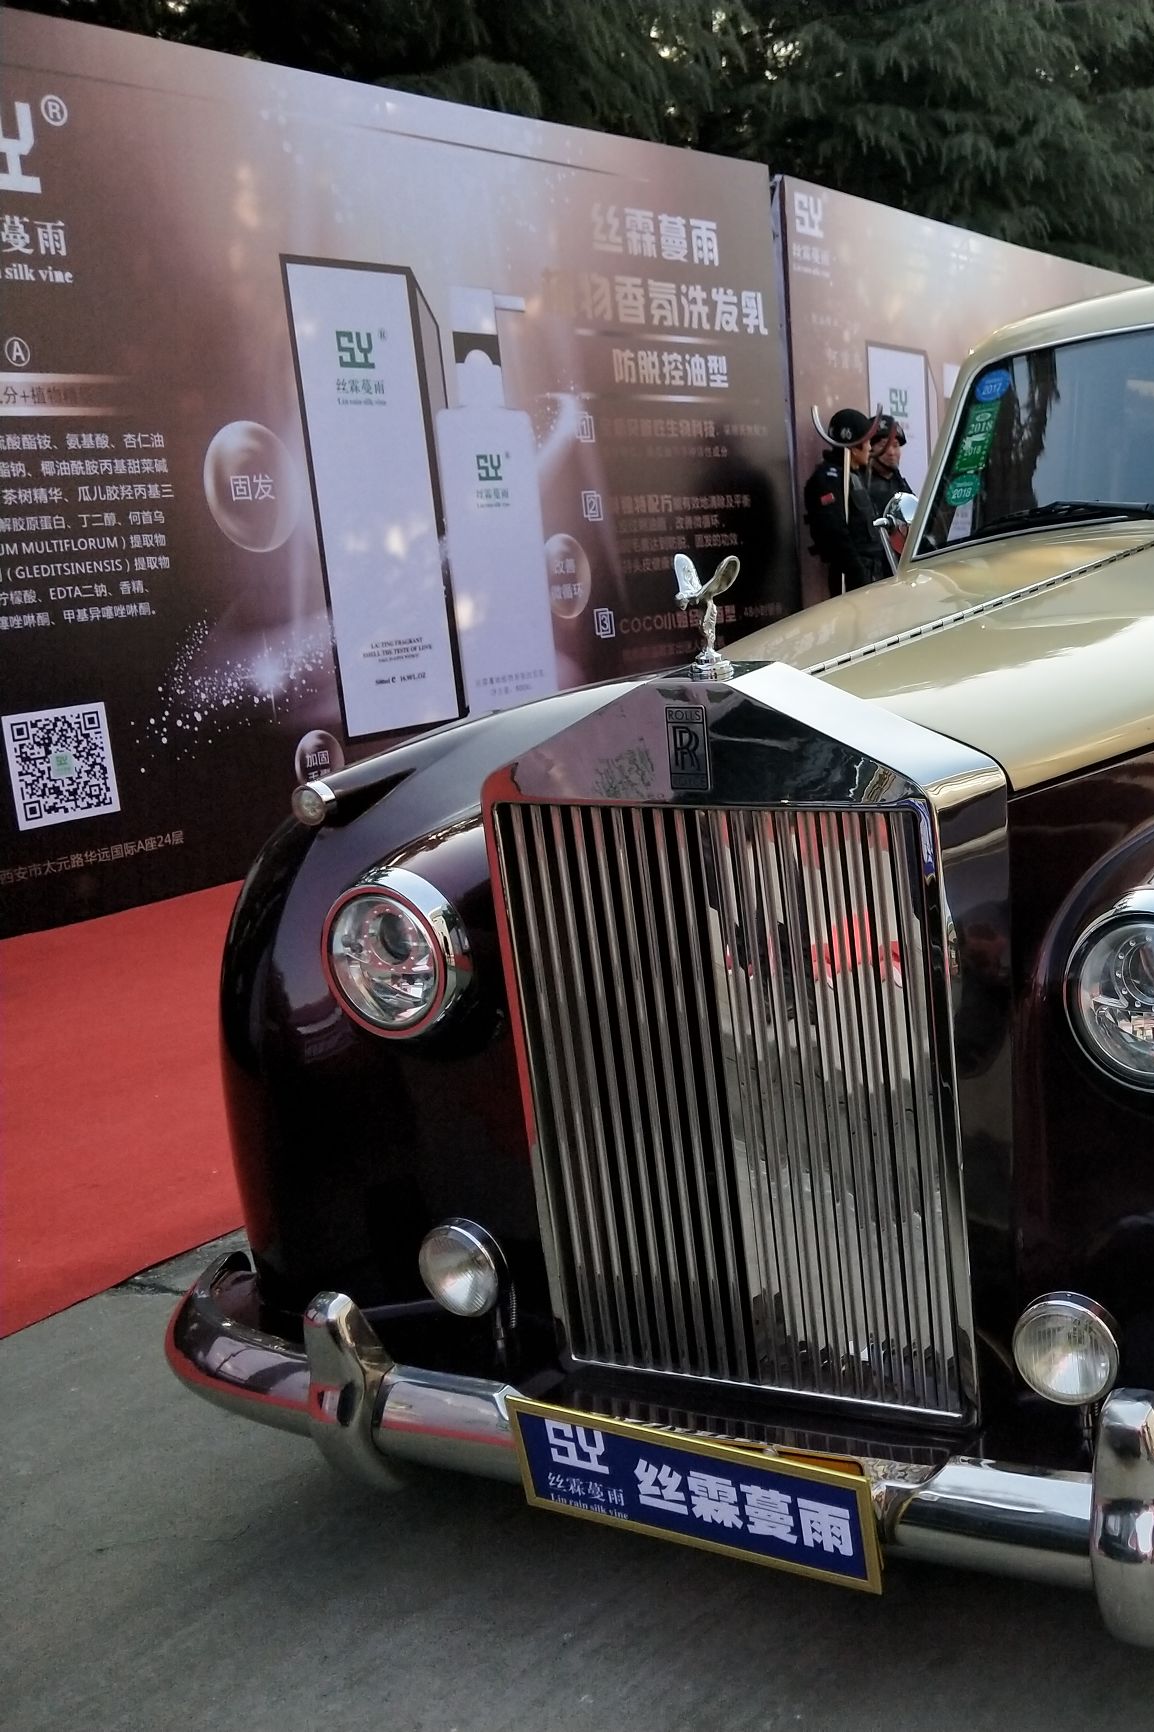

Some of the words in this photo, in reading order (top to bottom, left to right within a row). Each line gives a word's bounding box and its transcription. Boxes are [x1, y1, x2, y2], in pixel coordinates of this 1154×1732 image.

[794, 192, 824, 238] SY
[0, 214, 67, 256] 蔓雨
[590, 203, 719, 267] 丝霖蔓雨
[5, 263, 36, 281] silk
[38, 266, 74, 284] vine
[546, 268, 768, 336] 物香氛洗发乳
[335, 330, 375, 369] SY
[612, 348, 729, 389] 防脱控油型
[889, 388, 908, 417] SY
[982, 383, 1002, 396] 2017
[969, 420, 993, 435] 2018
[476, 454, 502, 481] SY
[230, 474, 275, 502] 固发
[951, 487, 972, 499] 2018
[668, 709, 701, 721] ROLLS
[306, 750, 330, 768] 加固
[545, 1418, 610, 1475] SY
[547, 1472, 624, 1506] 丝霖蔓雨
[634, 1458, 855, 1557] 丝霖蔓雨
